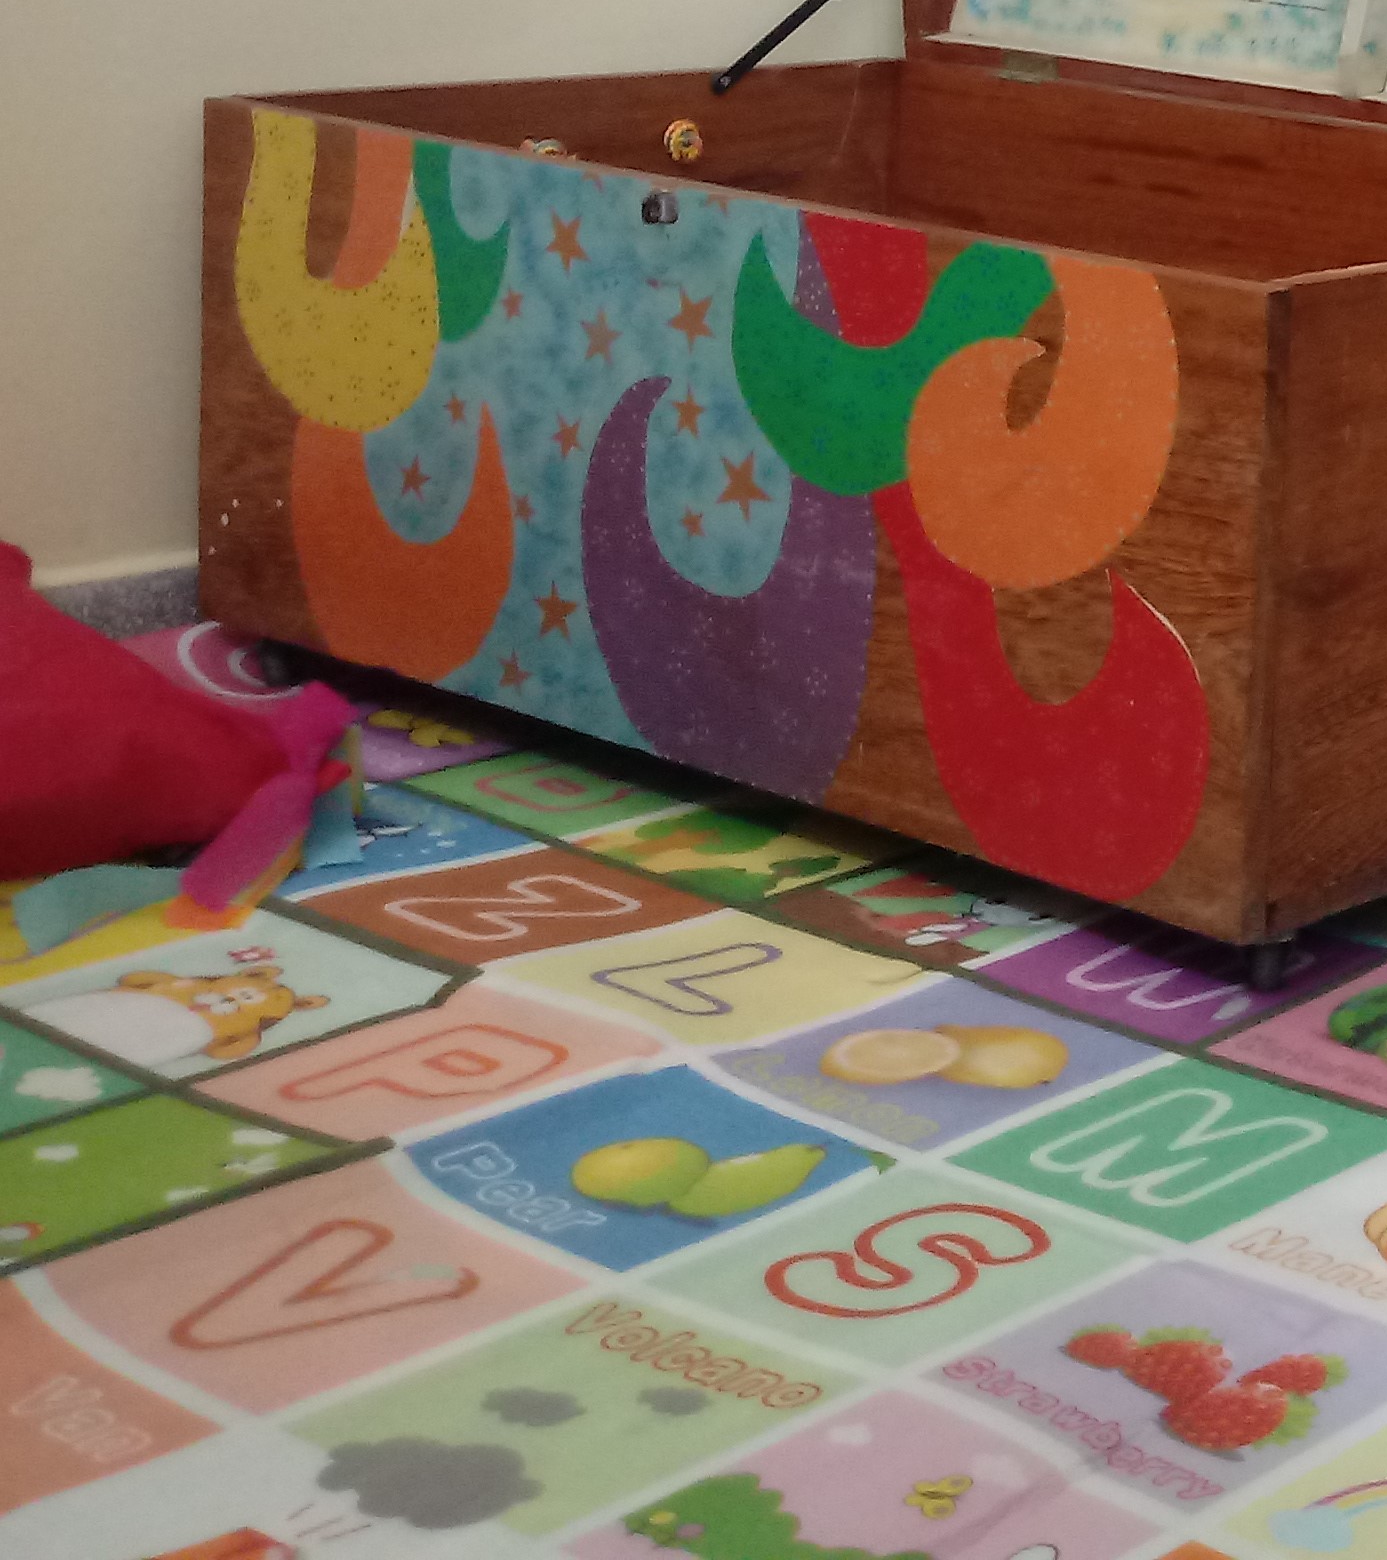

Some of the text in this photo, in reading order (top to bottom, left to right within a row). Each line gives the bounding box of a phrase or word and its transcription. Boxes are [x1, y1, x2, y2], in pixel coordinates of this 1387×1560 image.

[431, 1140, 607, 1233] Pear
[764, 1203, 1051, 1318] S
[565, 1301, 823, 1409] Volcano
[10, 1373, 153, 1464] Van
[942, 1356, 1226, 1501] Strawberry
